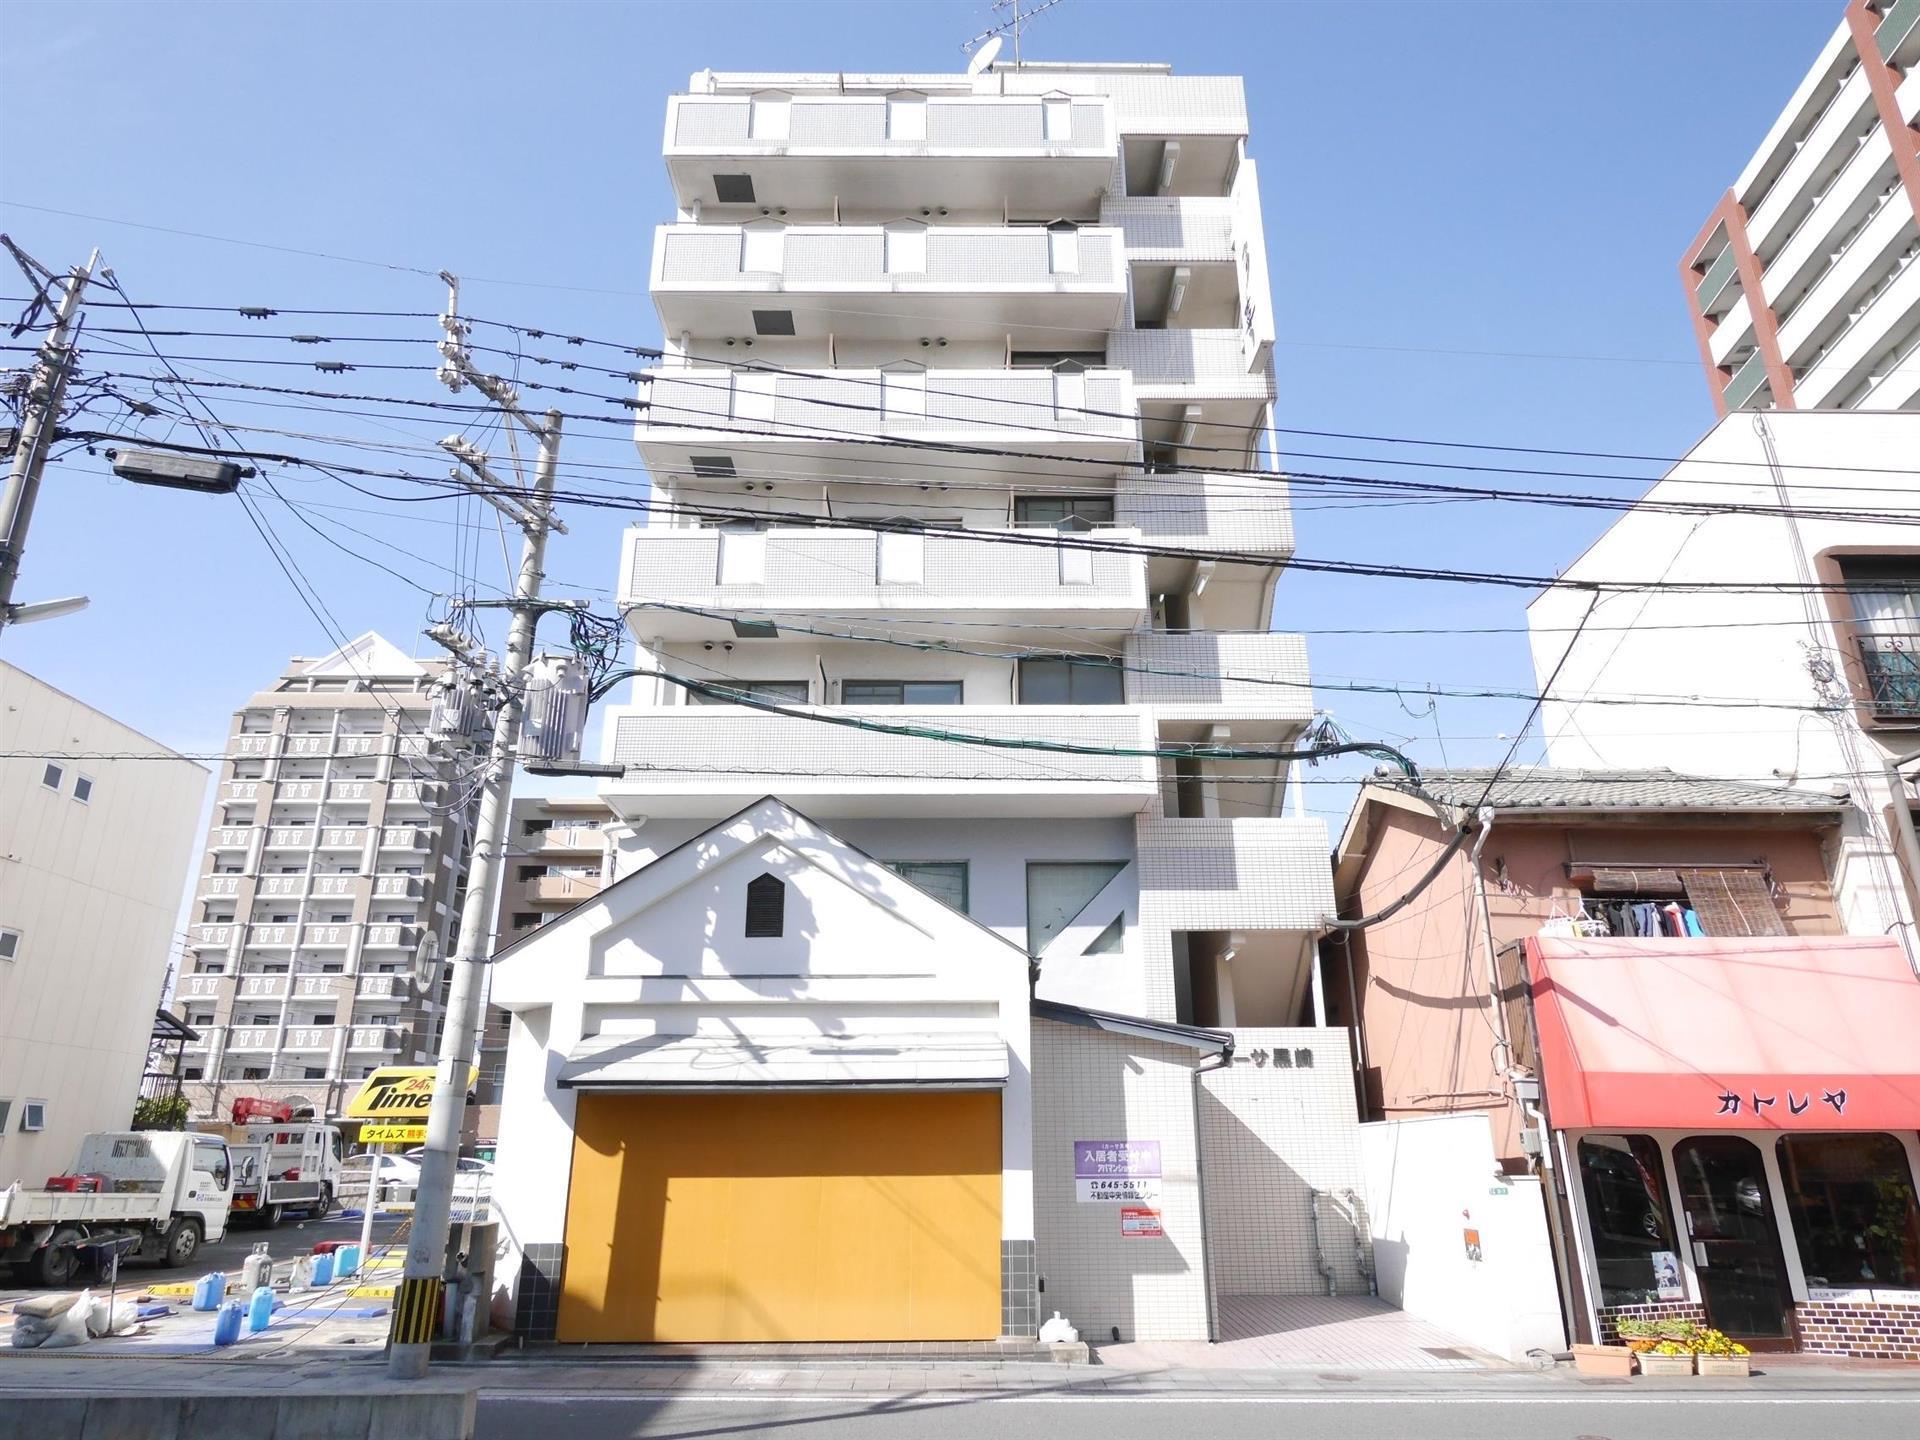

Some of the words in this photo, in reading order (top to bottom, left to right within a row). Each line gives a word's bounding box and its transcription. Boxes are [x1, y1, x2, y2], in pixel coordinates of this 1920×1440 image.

[1227, 1048, 1314, 1069] ーサ黒崎
[404, 1078, 431, 1091] 24h
[364, 1076, 434, 1111] Time
[1716, 1088, 1847, 1116] カトレヤ
[366, 1128, 405, 1139] タイムズ
[1100, 1181, 1147, 1189] 645-5511
